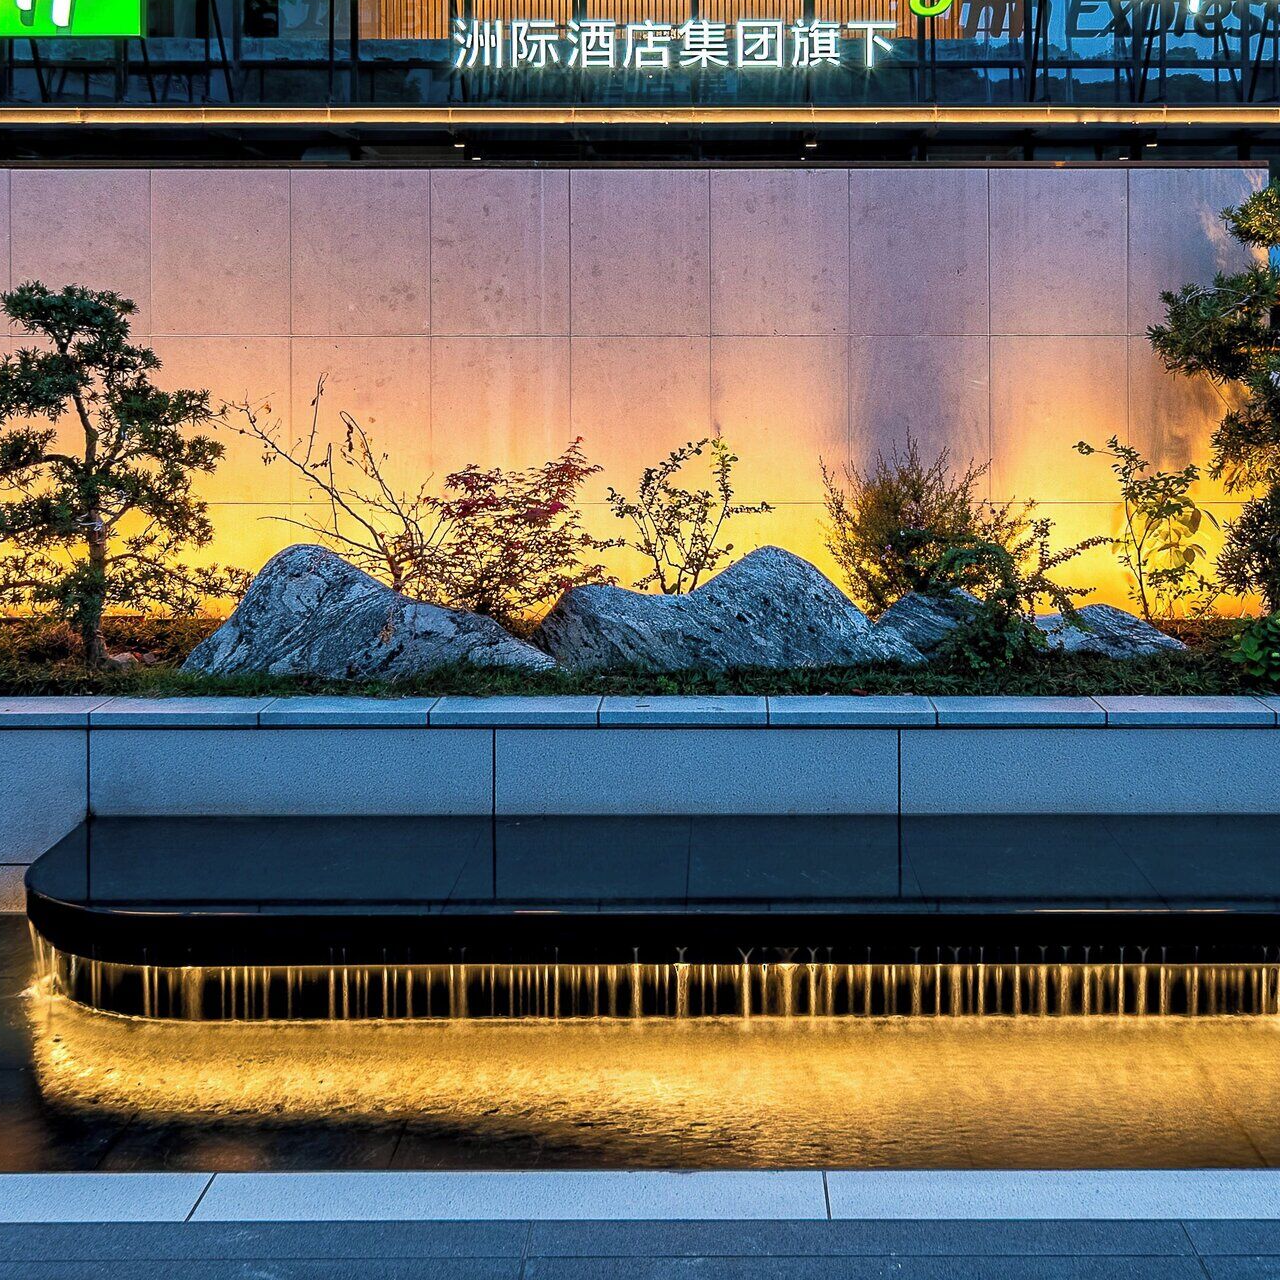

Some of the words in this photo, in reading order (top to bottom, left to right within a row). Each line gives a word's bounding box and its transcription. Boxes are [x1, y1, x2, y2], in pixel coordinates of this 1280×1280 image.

[453, 19, 898, 69] 洲际酒店集团旗下
